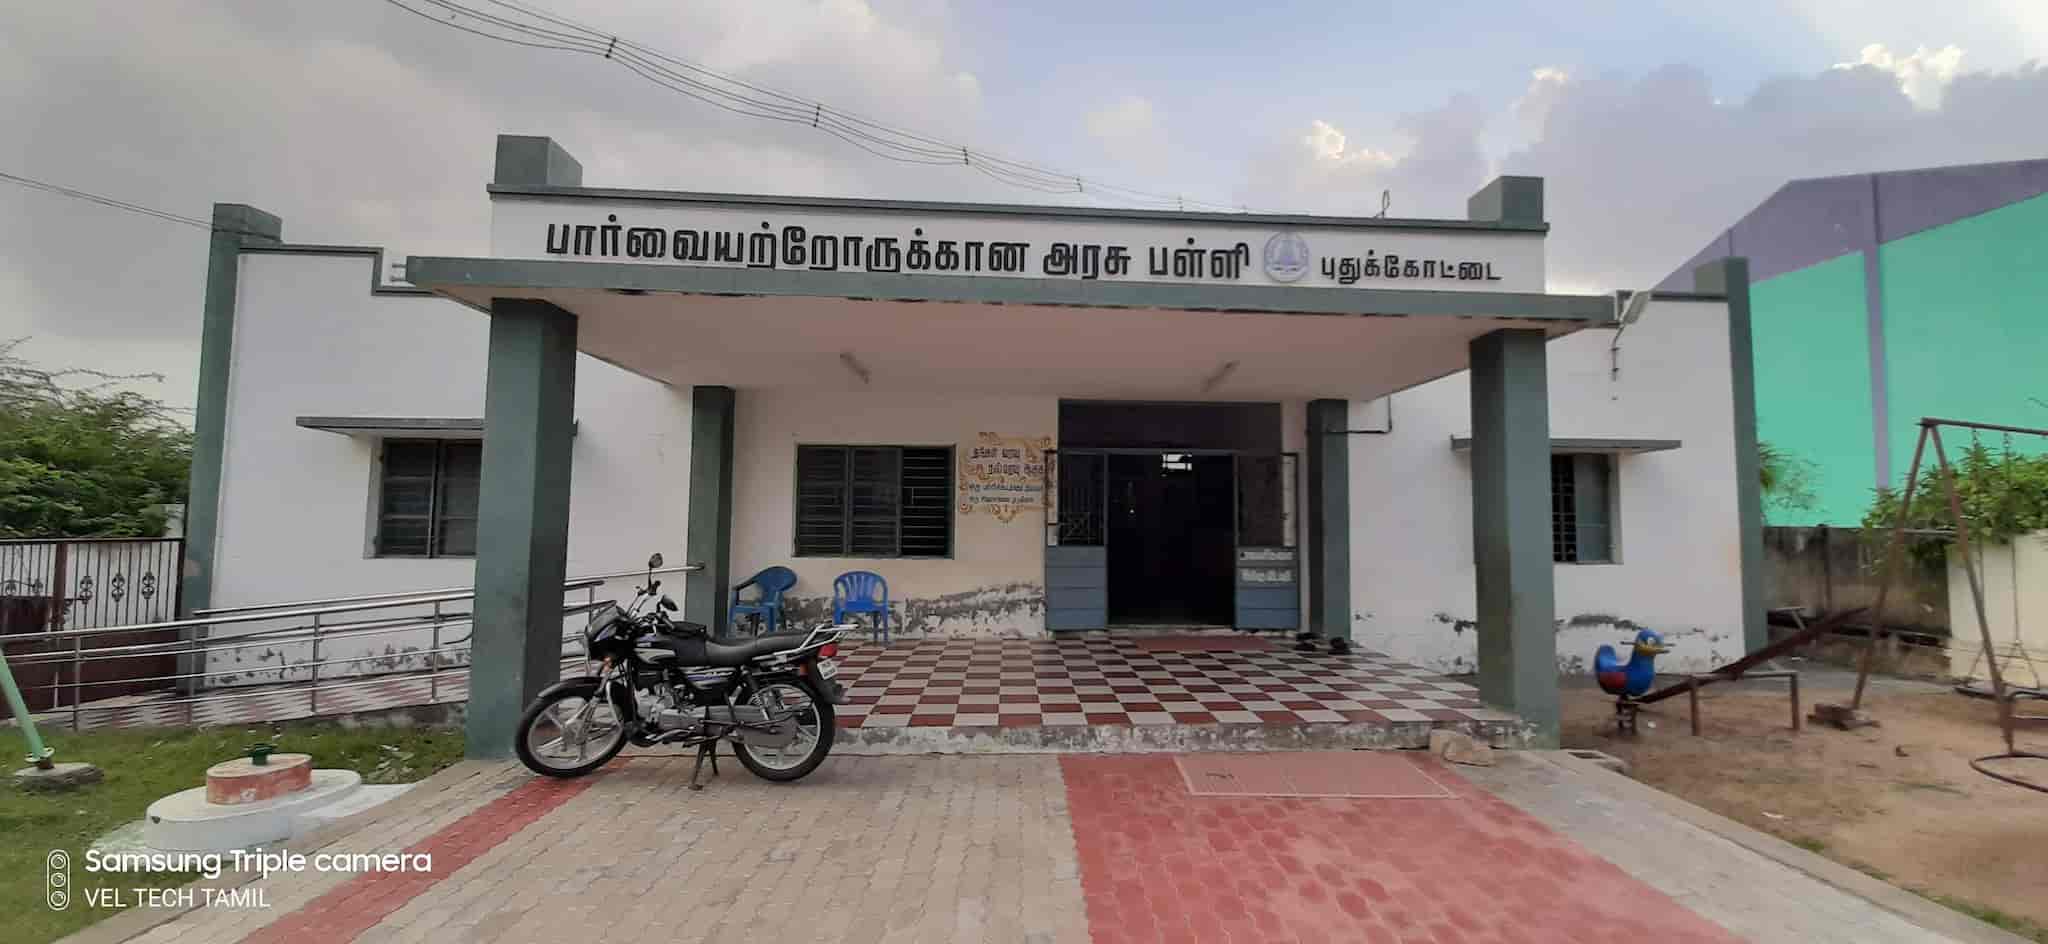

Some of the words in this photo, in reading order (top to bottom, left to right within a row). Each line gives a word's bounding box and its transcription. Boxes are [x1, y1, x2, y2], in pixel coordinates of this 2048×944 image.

[546, 214, 1030, 271] பார்வையற்றோருக்கான
[1042, 240, 1132, 280] அரசு
[1149, 237, 1250, 280] பள்ளி
[1321, 249, 1502, 284] புதுக்கோட்டை
